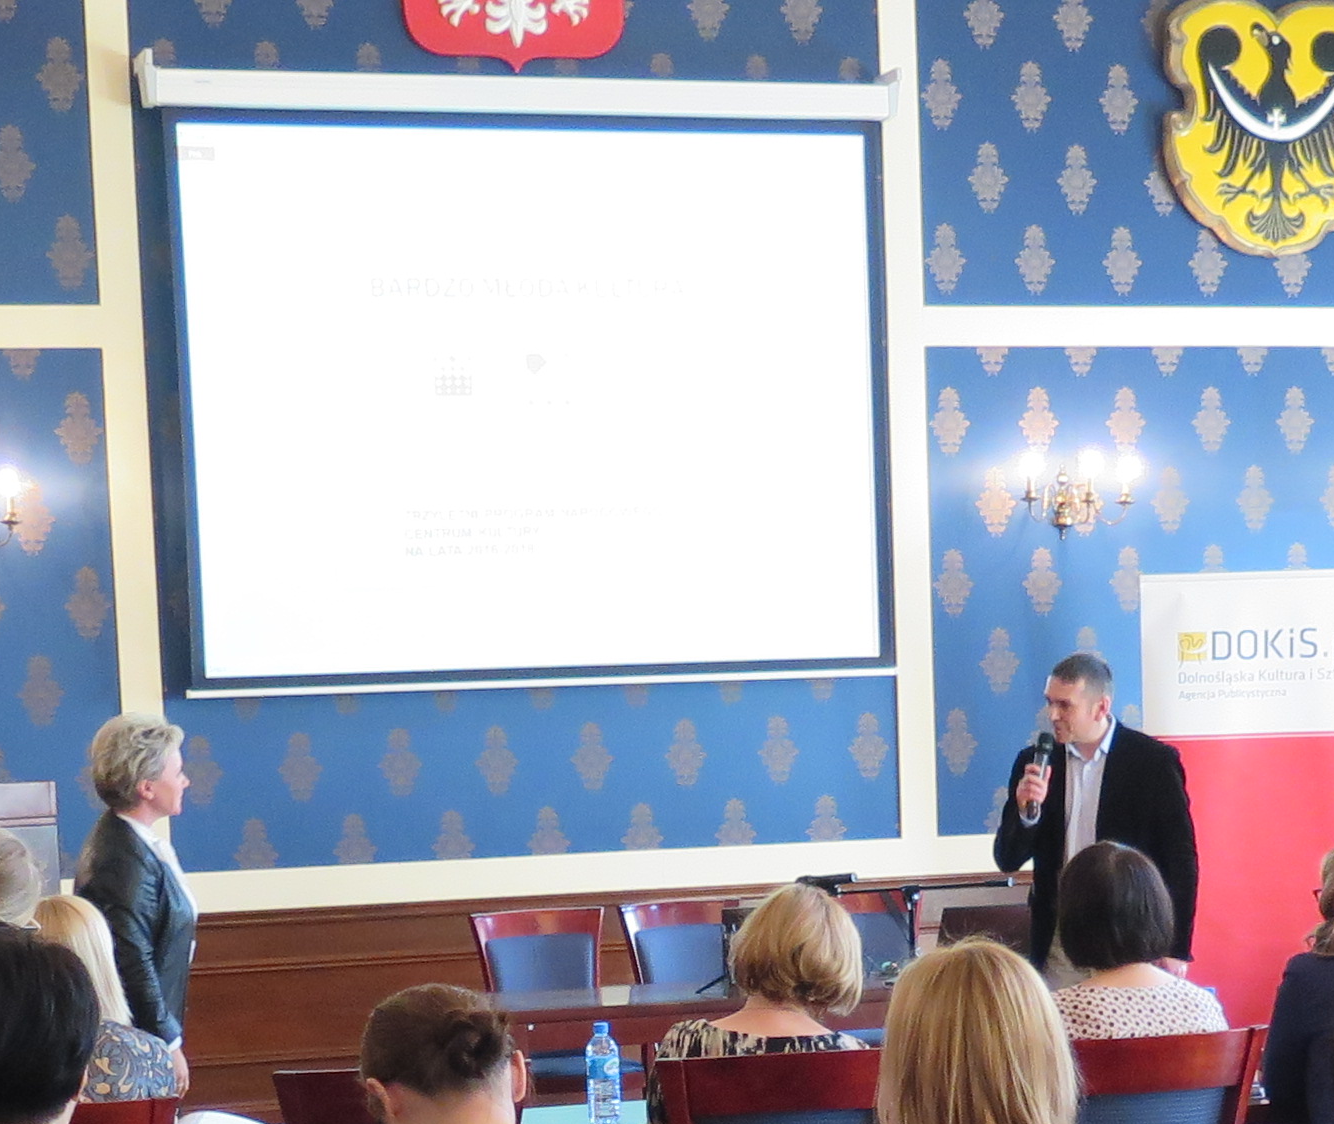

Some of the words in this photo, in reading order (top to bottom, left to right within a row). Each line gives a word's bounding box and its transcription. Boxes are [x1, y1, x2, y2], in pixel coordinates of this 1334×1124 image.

[370, 277, 474, 298] BARDZO
[482, 278, 570, 298] MŁODA
[1177, 669, 1255, 686] Dolnośląska
[1258, 668, 1306, 682] Kultura
[1178, 689, 1216, 701] Agencja
[1218, 688, 1288, 700] Publicystyczna
